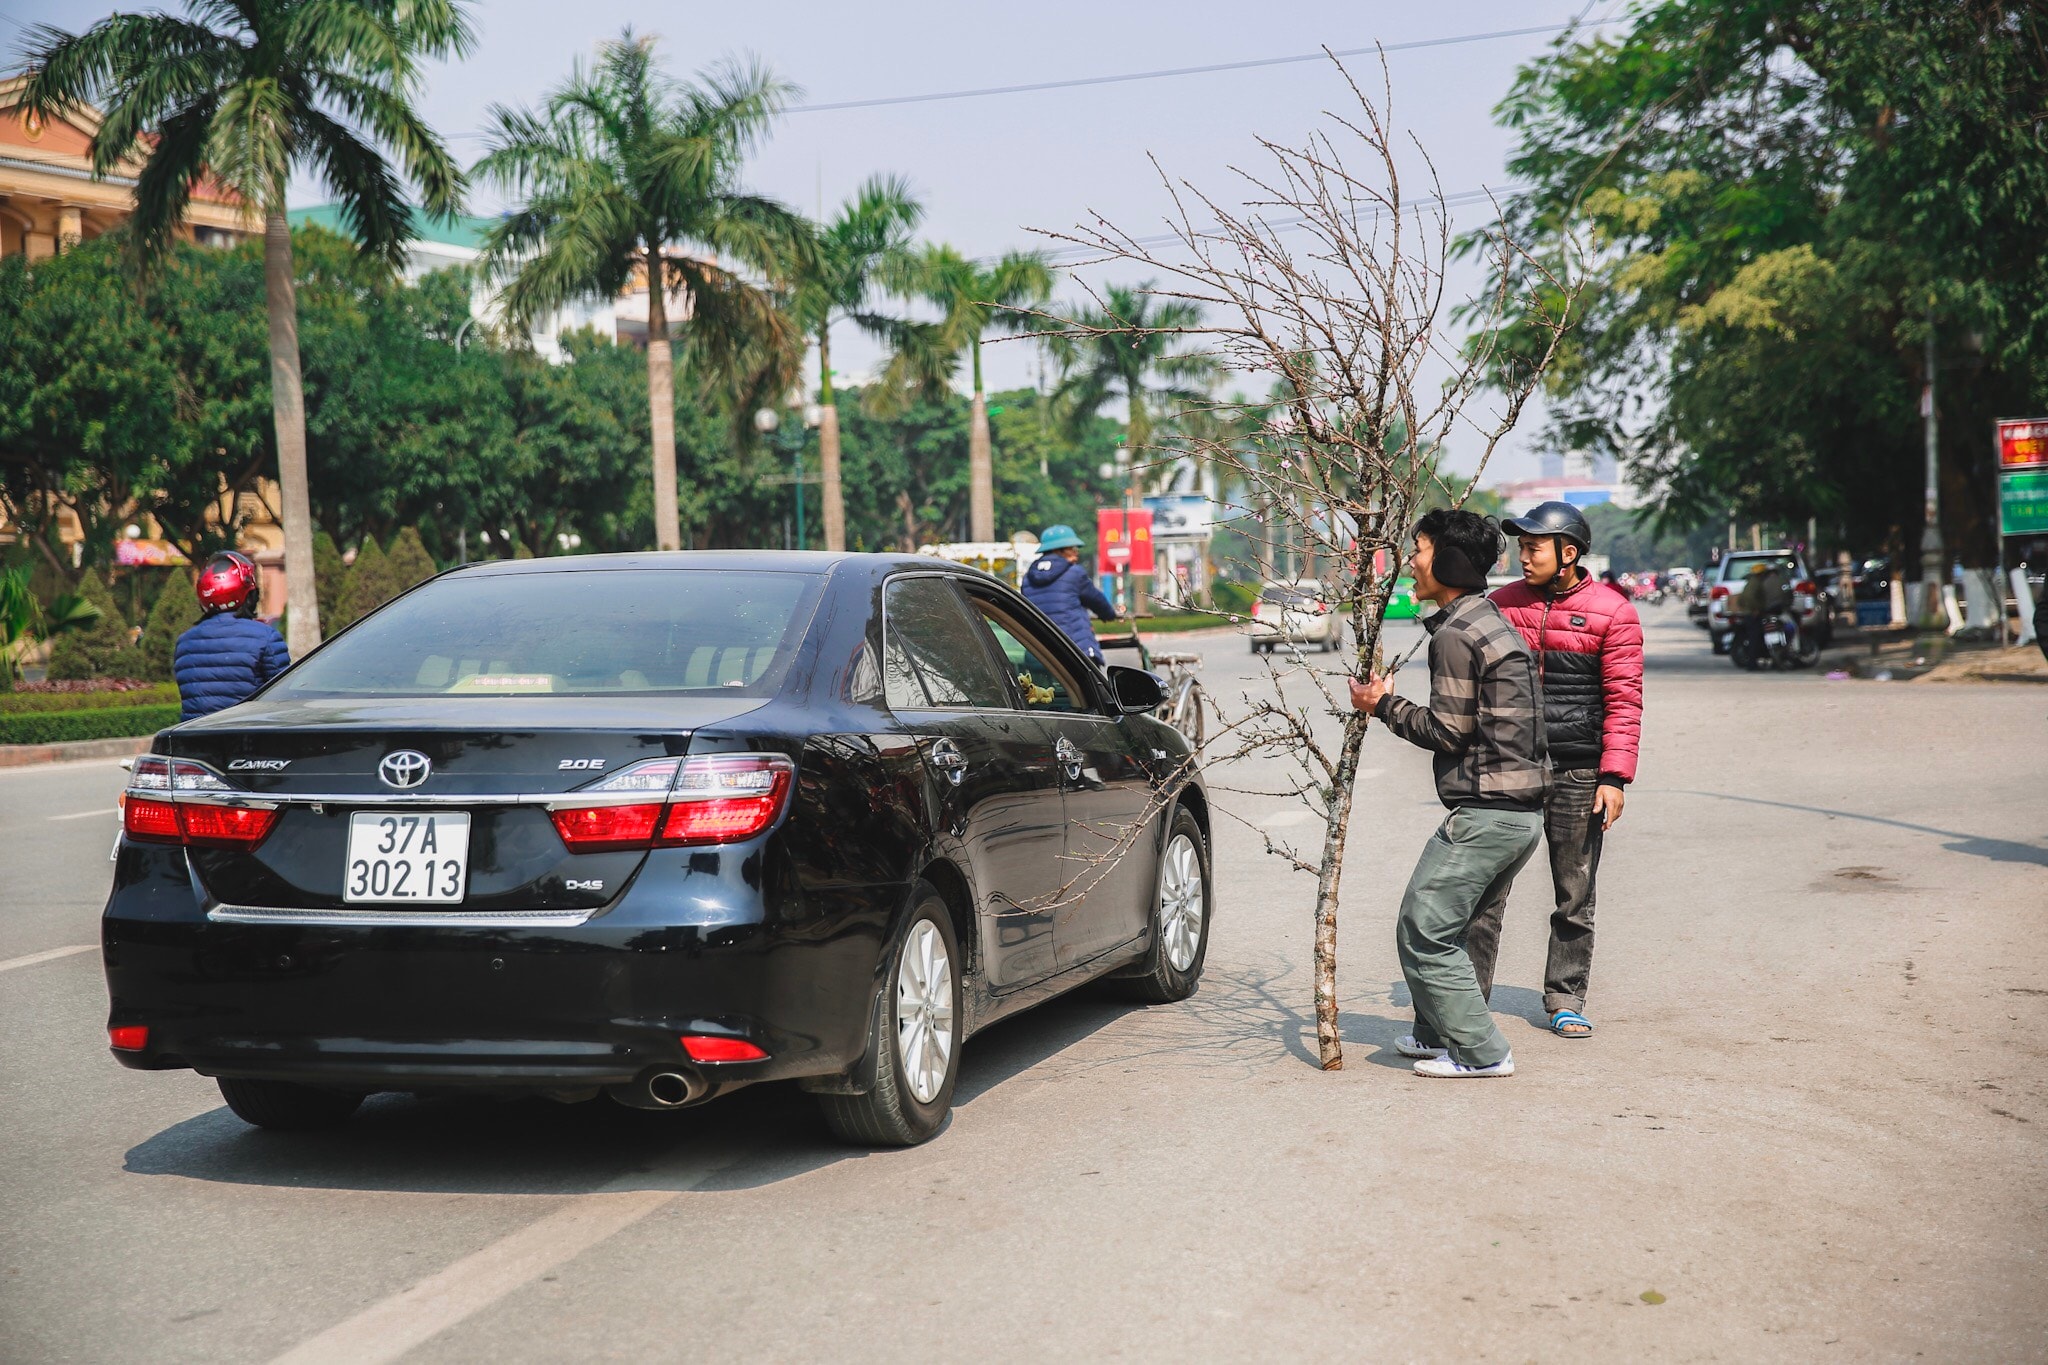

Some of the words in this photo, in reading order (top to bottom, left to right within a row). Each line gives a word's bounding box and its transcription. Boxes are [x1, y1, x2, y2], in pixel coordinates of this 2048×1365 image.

[228, 759, 292, 771] CAMRY
[378, 817, 437, 854] 37A
[350, 859, 461, 897] 302.13
[566, 879, 603, 890] D-4S
